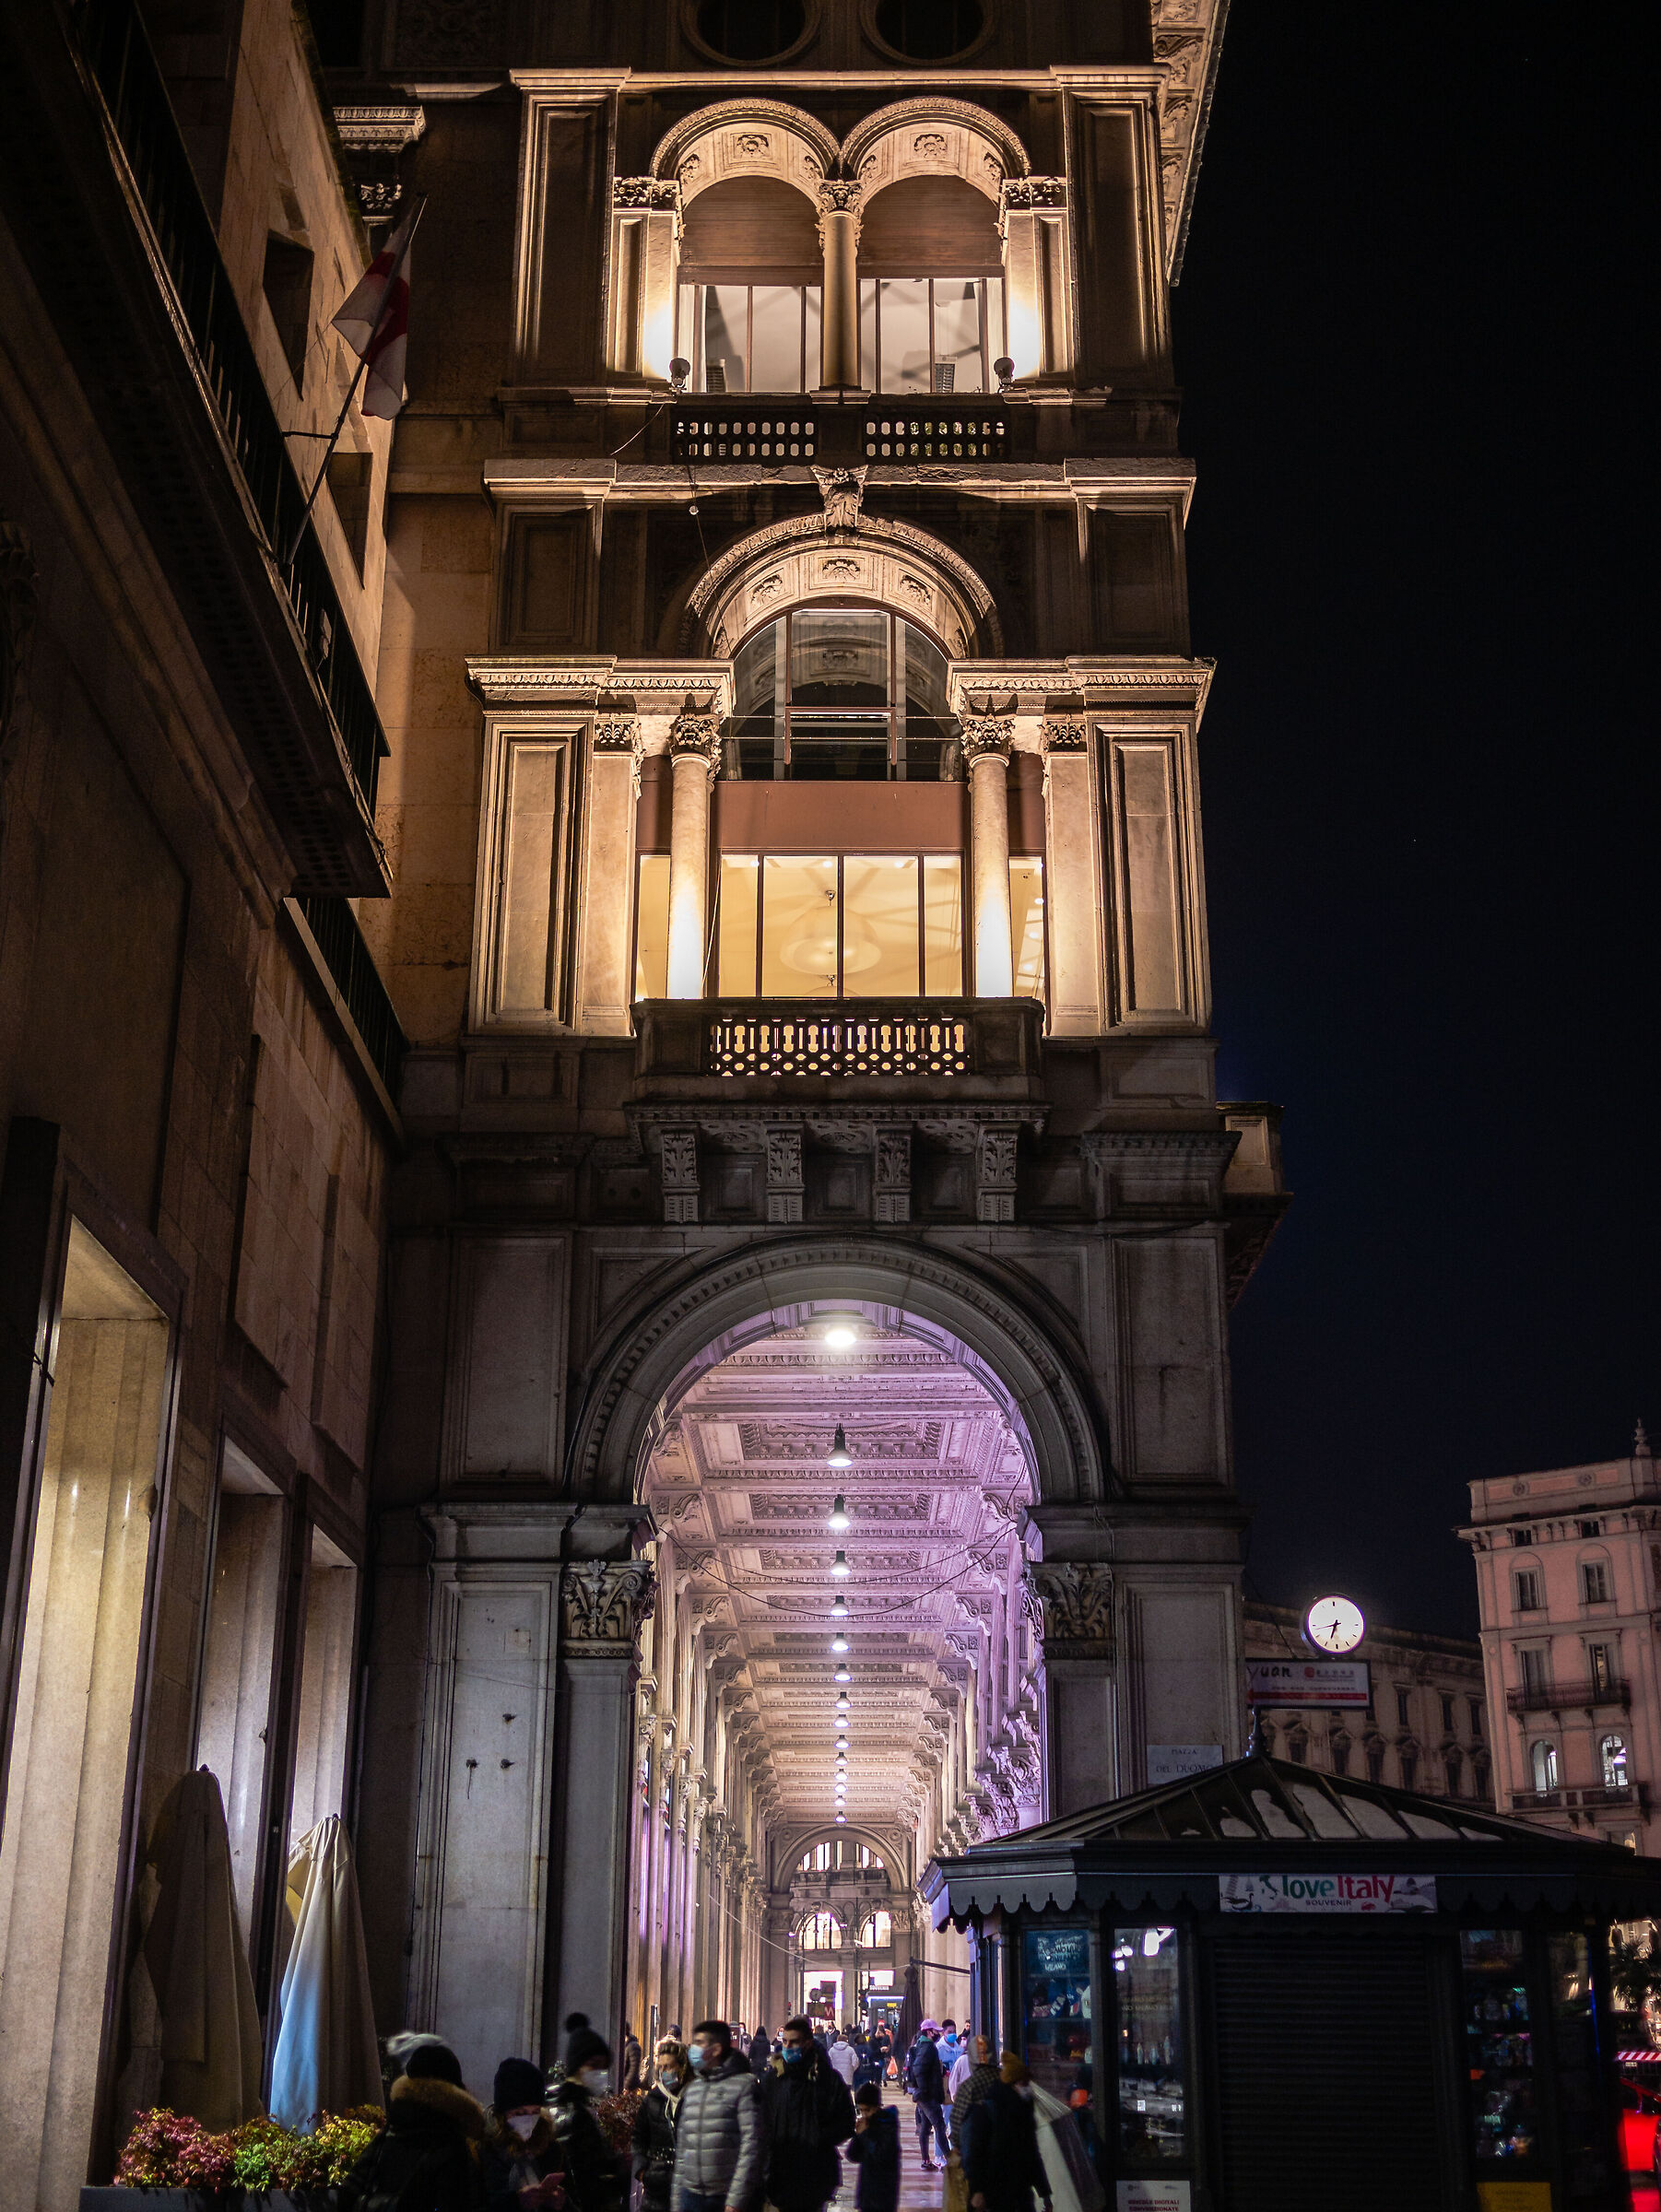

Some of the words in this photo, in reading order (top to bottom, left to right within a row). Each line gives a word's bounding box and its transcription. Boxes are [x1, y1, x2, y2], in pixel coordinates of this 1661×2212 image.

[1171, 1747, 1198, 1756] PIAZZA
[1156, 1764, 1172, 1773] DEL
[1305, 1899, 1352, 1907] SOUVENIR
